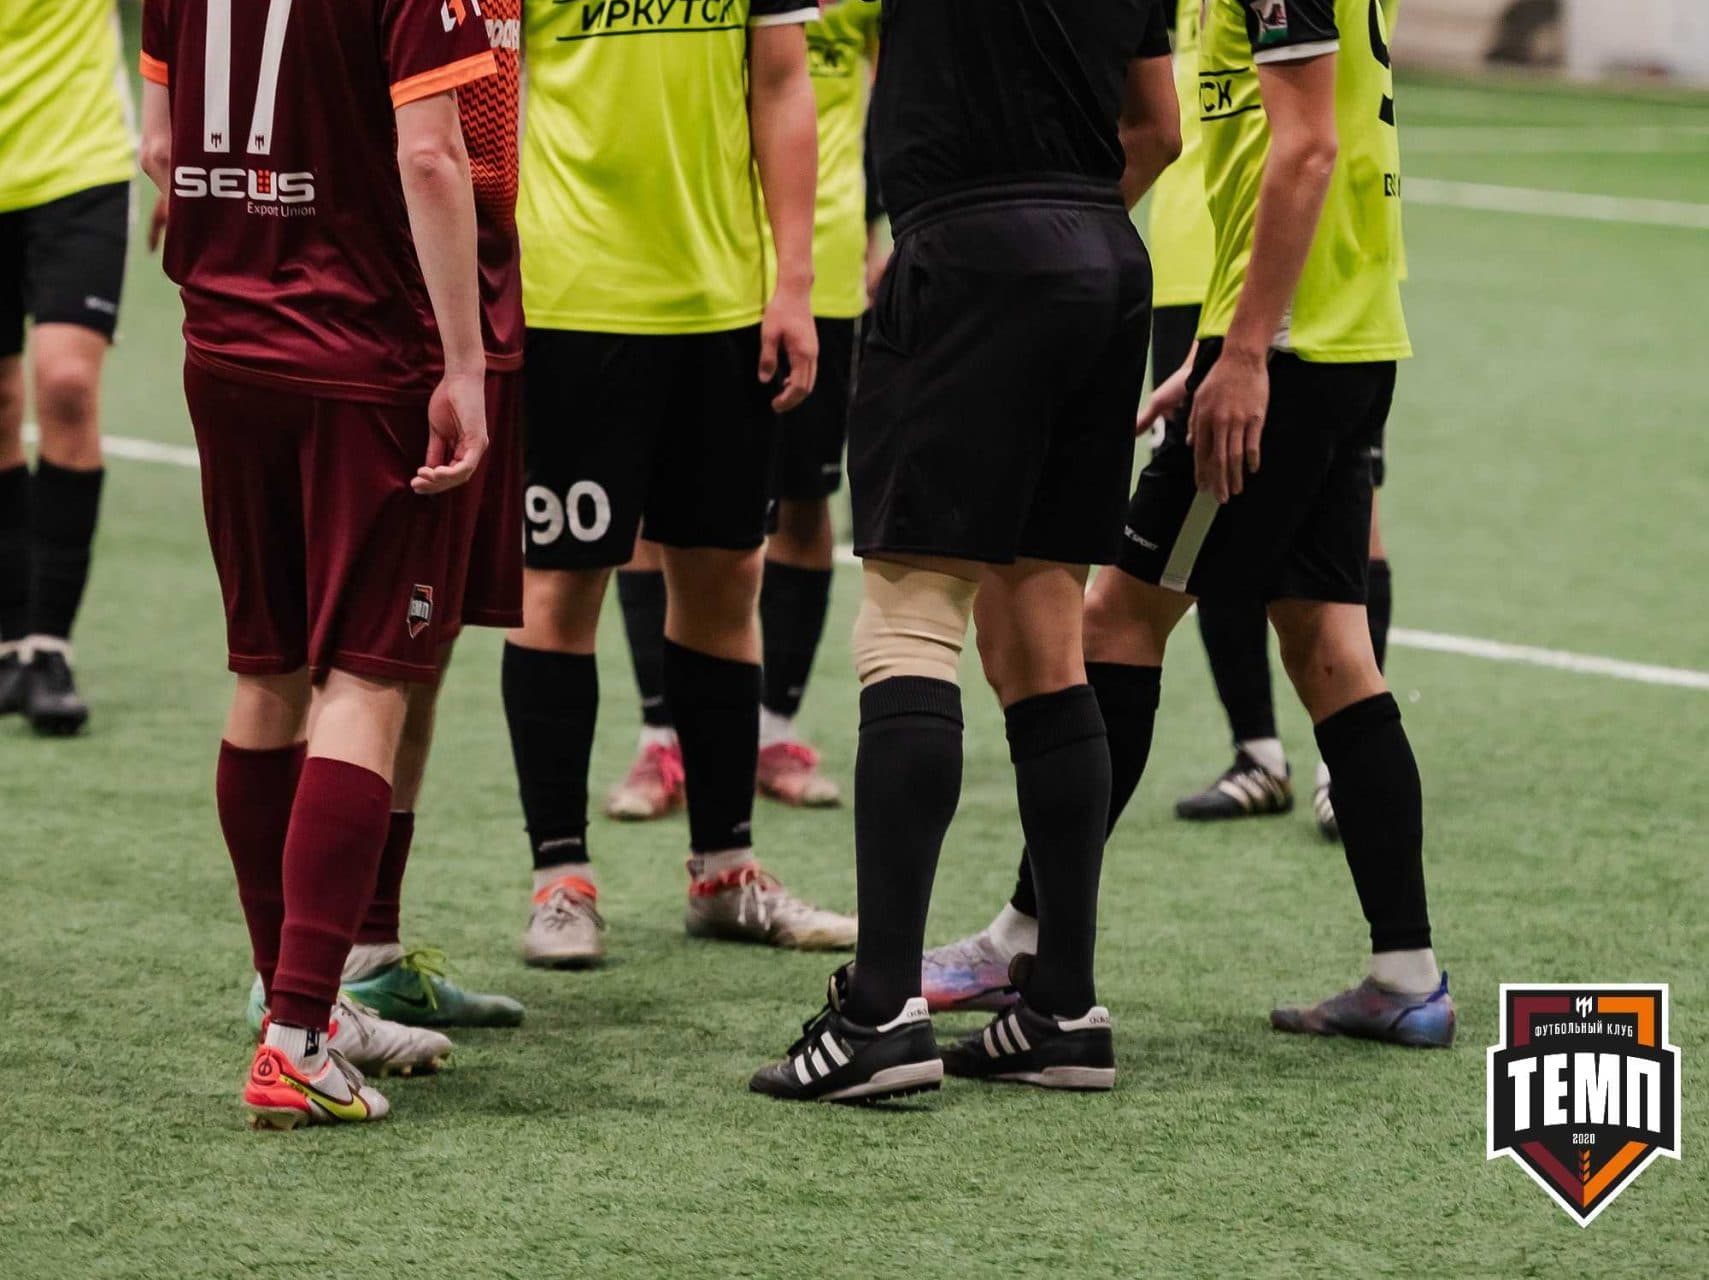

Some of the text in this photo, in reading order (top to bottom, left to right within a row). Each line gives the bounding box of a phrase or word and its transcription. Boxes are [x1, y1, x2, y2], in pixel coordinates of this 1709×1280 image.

[174, 166, 316, 204] SEUS
[247, 201, 316, 218] Export Union
[525, 480, 611, 545] 90
